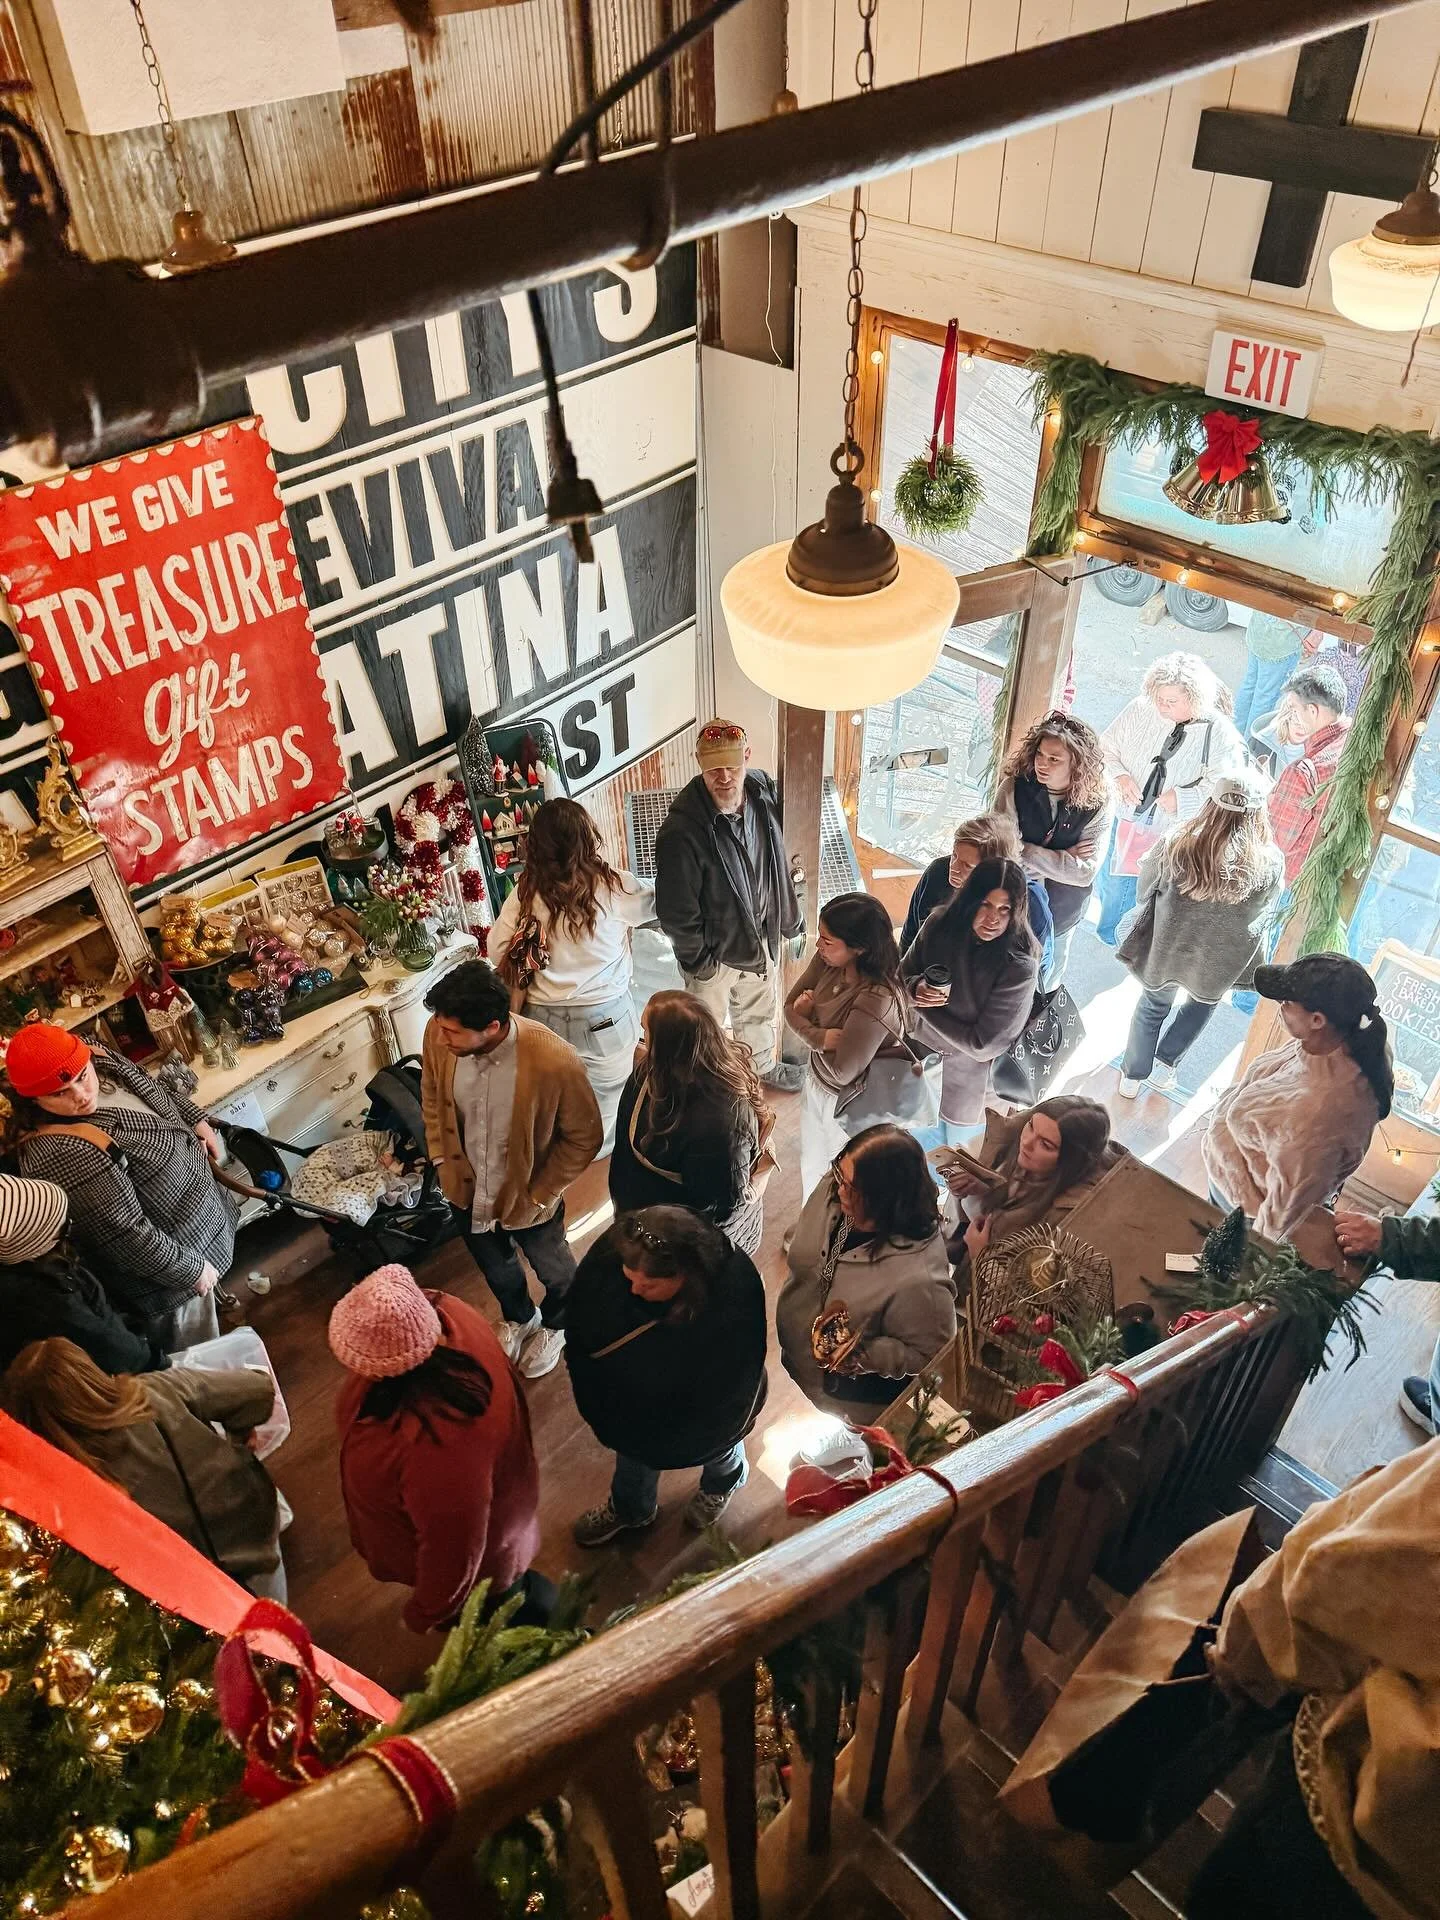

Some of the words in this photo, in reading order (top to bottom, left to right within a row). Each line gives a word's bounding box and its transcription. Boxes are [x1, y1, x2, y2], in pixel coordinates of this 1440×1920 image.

[1224, 338, 1302, 407] EXIT
[35, 495, 127, 560] WE
[131, 459, 234, 532] GIVE
[285, 404, 566, 612] EVIVA
[23, 520, 297, 693] TREASURE
[143, 652, 251, 770] gift
[123, 725, 314, 856] STAMPS
[1373, 994, 1440, 1041] COOKIES
[1399, 987, 1436, 1013] BAKED
[1403, 975, 1440, 1004] FRESH
